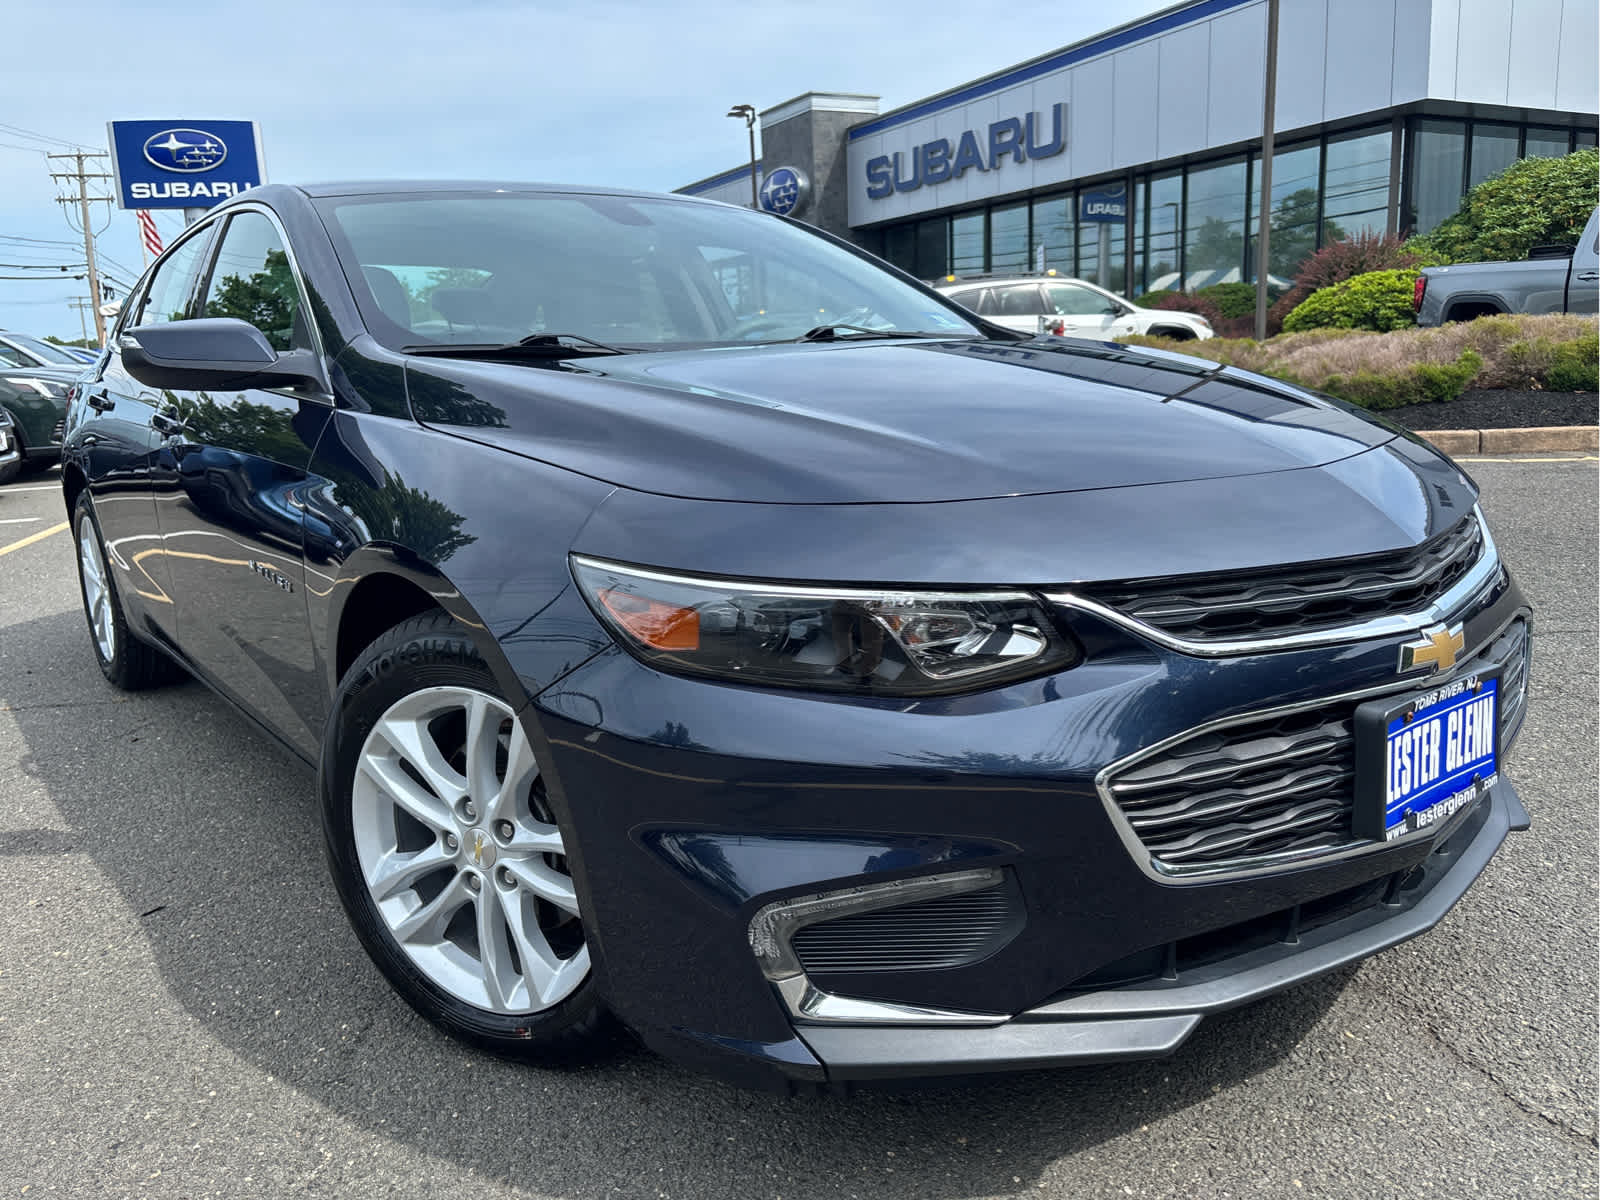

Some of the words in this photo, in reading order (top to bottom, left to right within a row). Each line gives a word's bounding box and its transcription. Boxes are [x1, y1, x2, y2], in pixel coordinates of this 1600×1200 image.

[866, 103, 1067, 199] SUBARU
[366, 638, 486, 680] YOKOHAM
[1414, 692, 1438, 712] TOMS
[1466, 676, 1478, 689] NJ
[1386, 718, 1440, 805] LESTER
[1445, 695, 1494, 772] GLENN
